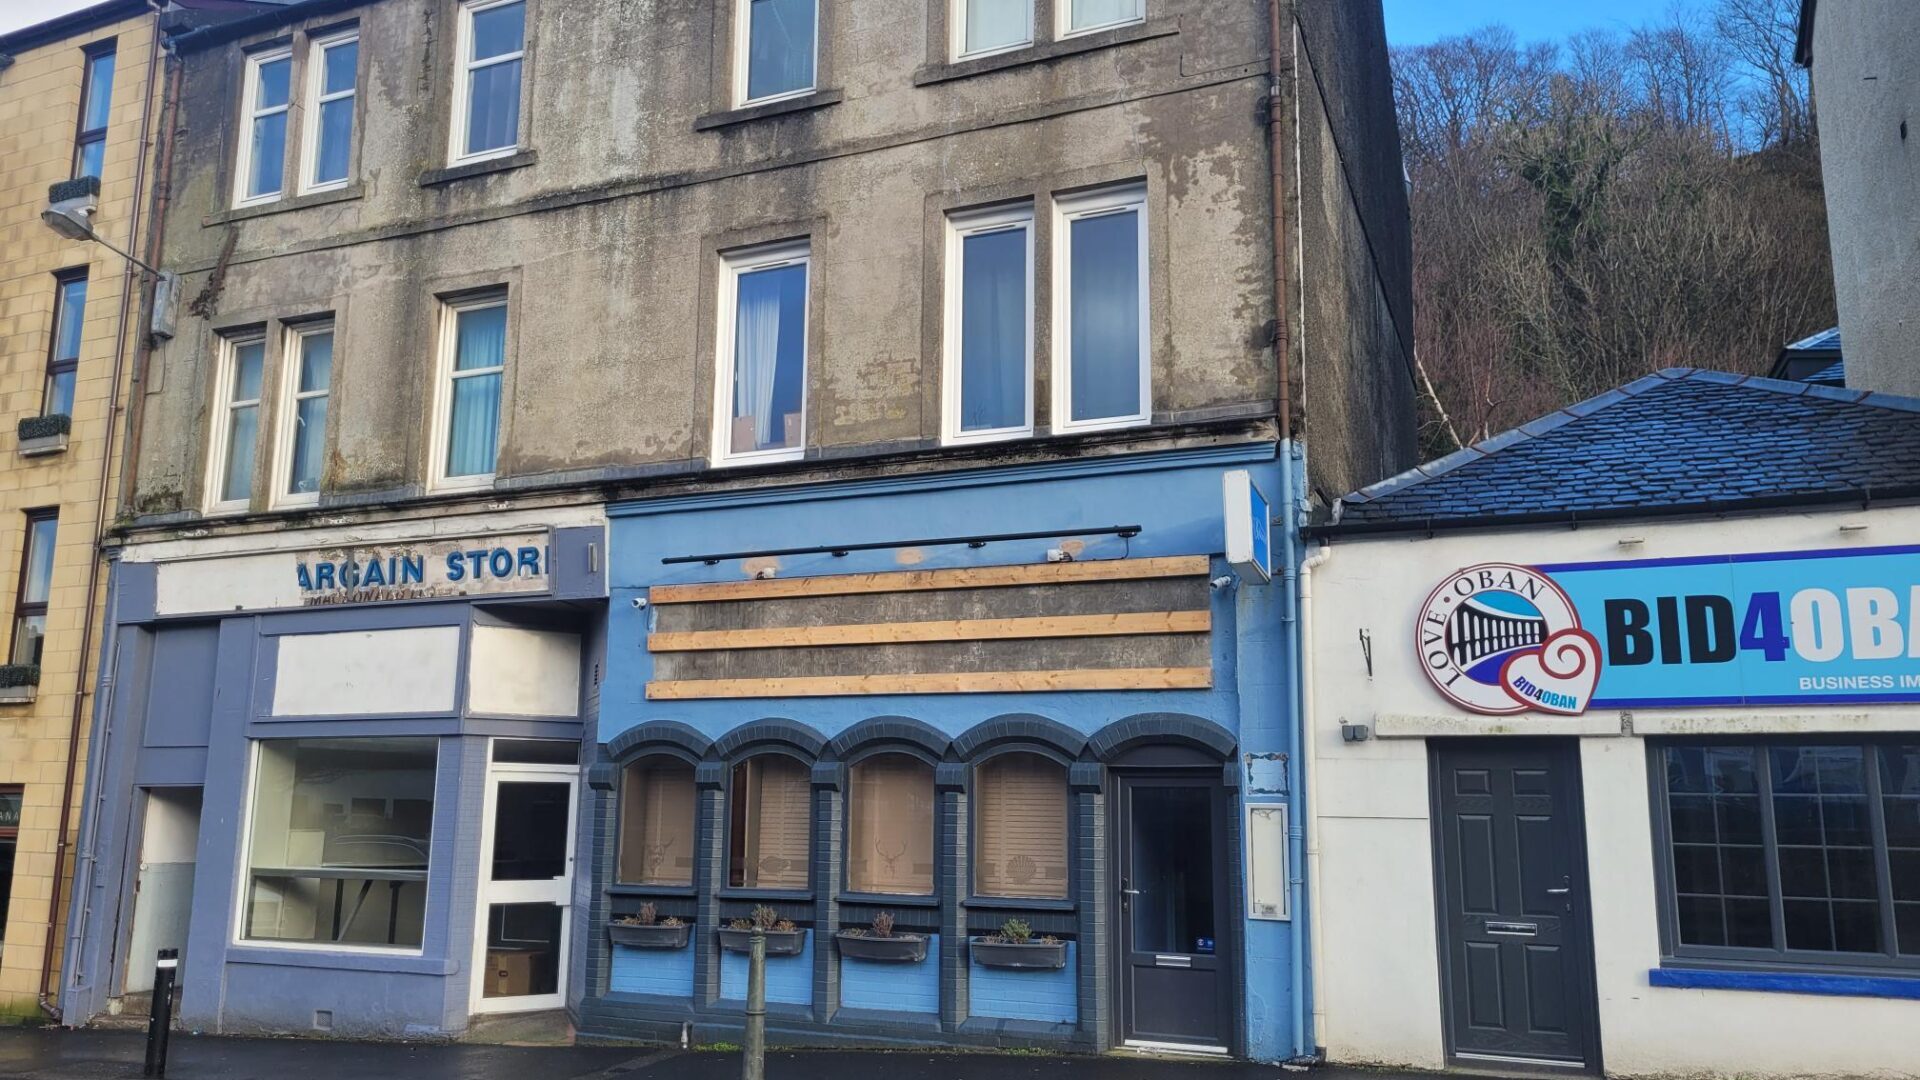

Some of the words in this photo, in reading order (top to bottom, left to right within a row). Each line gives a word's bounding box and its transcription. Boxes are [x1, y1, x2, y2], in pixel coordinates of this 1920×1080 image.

[1424, 610, 1463, 688] LOVE
[1454, 570, 1547, 600] OBAN
[1605, 585, 1920, 666] BID4OB
[1513, 675, 1577, 709] BID4OBAN
[1799, 675, 1895, 690] BUSINESS
